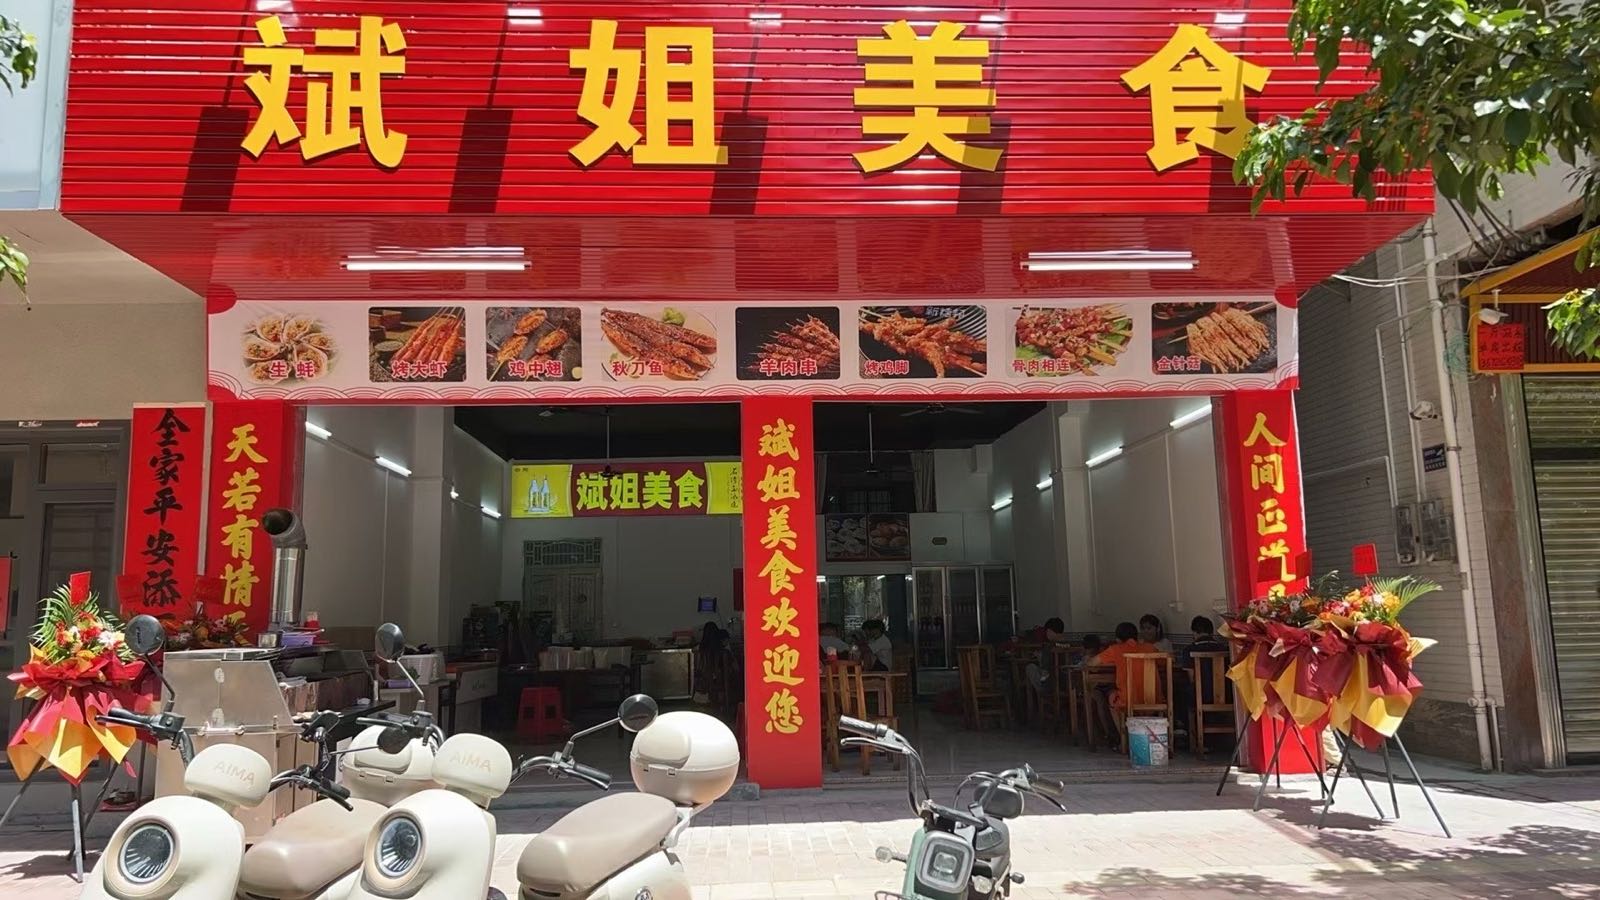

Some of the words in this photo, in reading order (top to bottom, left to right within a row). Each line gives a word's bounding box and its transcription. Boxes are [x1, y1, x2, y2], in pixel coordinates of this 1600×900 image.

[241, 15, 1272, 172] 斌姐美食
[269, 360, 315, 379] 生蚝
[392, 360, 448, 379] 烤大虾
[508, 360, 564, 378] 鸡中翅
[612, 361, 664, 376] 秋刀鱼
[759, 358, 818, 376] 羊肉串
[864, 360, 909, 375] 烤鸡脚
[1011, 359, 1070, 373] 骨肉相连
[1156, 356, 1201, 372] 金针菇
[576, 470, 705, 511] 斌姐美食
[140, 408, 190, 620] 全家平安添
[758, 418, 804, 735] 斌姐美食欢迎您
[449, 751, 492, 774] AIMA
[214, 760, 255, 786] AIMA
